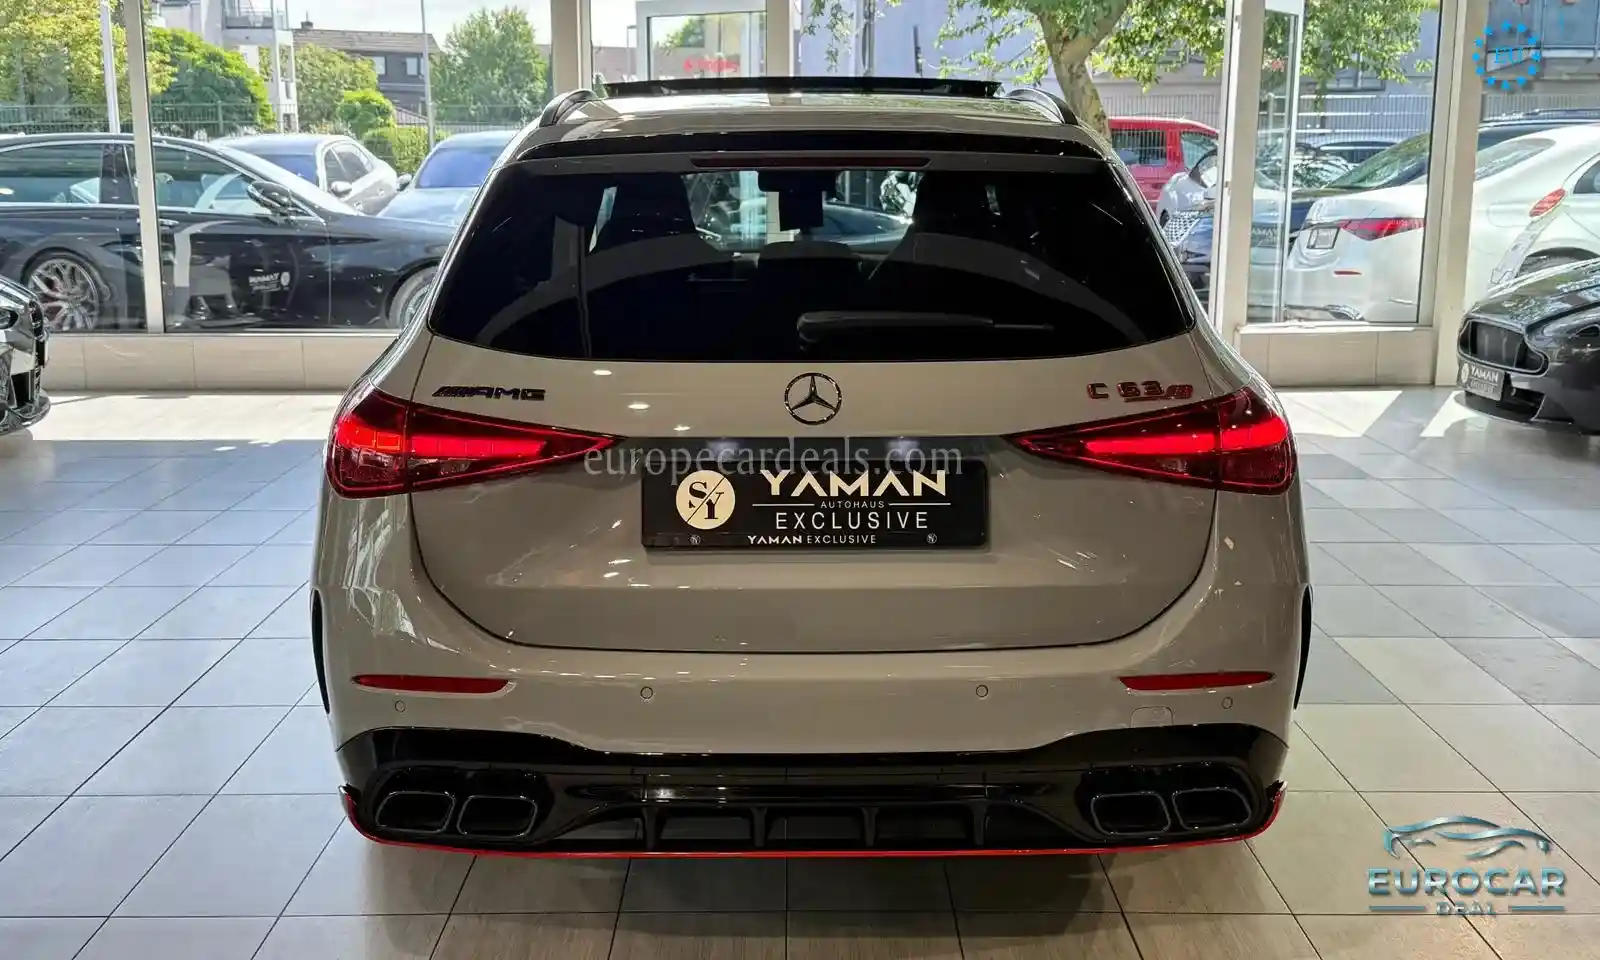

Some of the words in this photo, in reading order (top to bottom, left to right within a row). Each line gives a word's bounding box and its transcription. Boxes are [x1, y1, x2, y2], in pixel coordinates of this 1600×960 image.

[1087, 383, 1109, 399] C
[760, 469, 947, 497] YAMAN
[820, 500, 885, 509] AUTOHAUS
[775, 511, 929, 530] EXCLUSIVE
[747, 534, 803, 545] YAMAN
[806, 534, 877, 545] EXCLUSIVE
